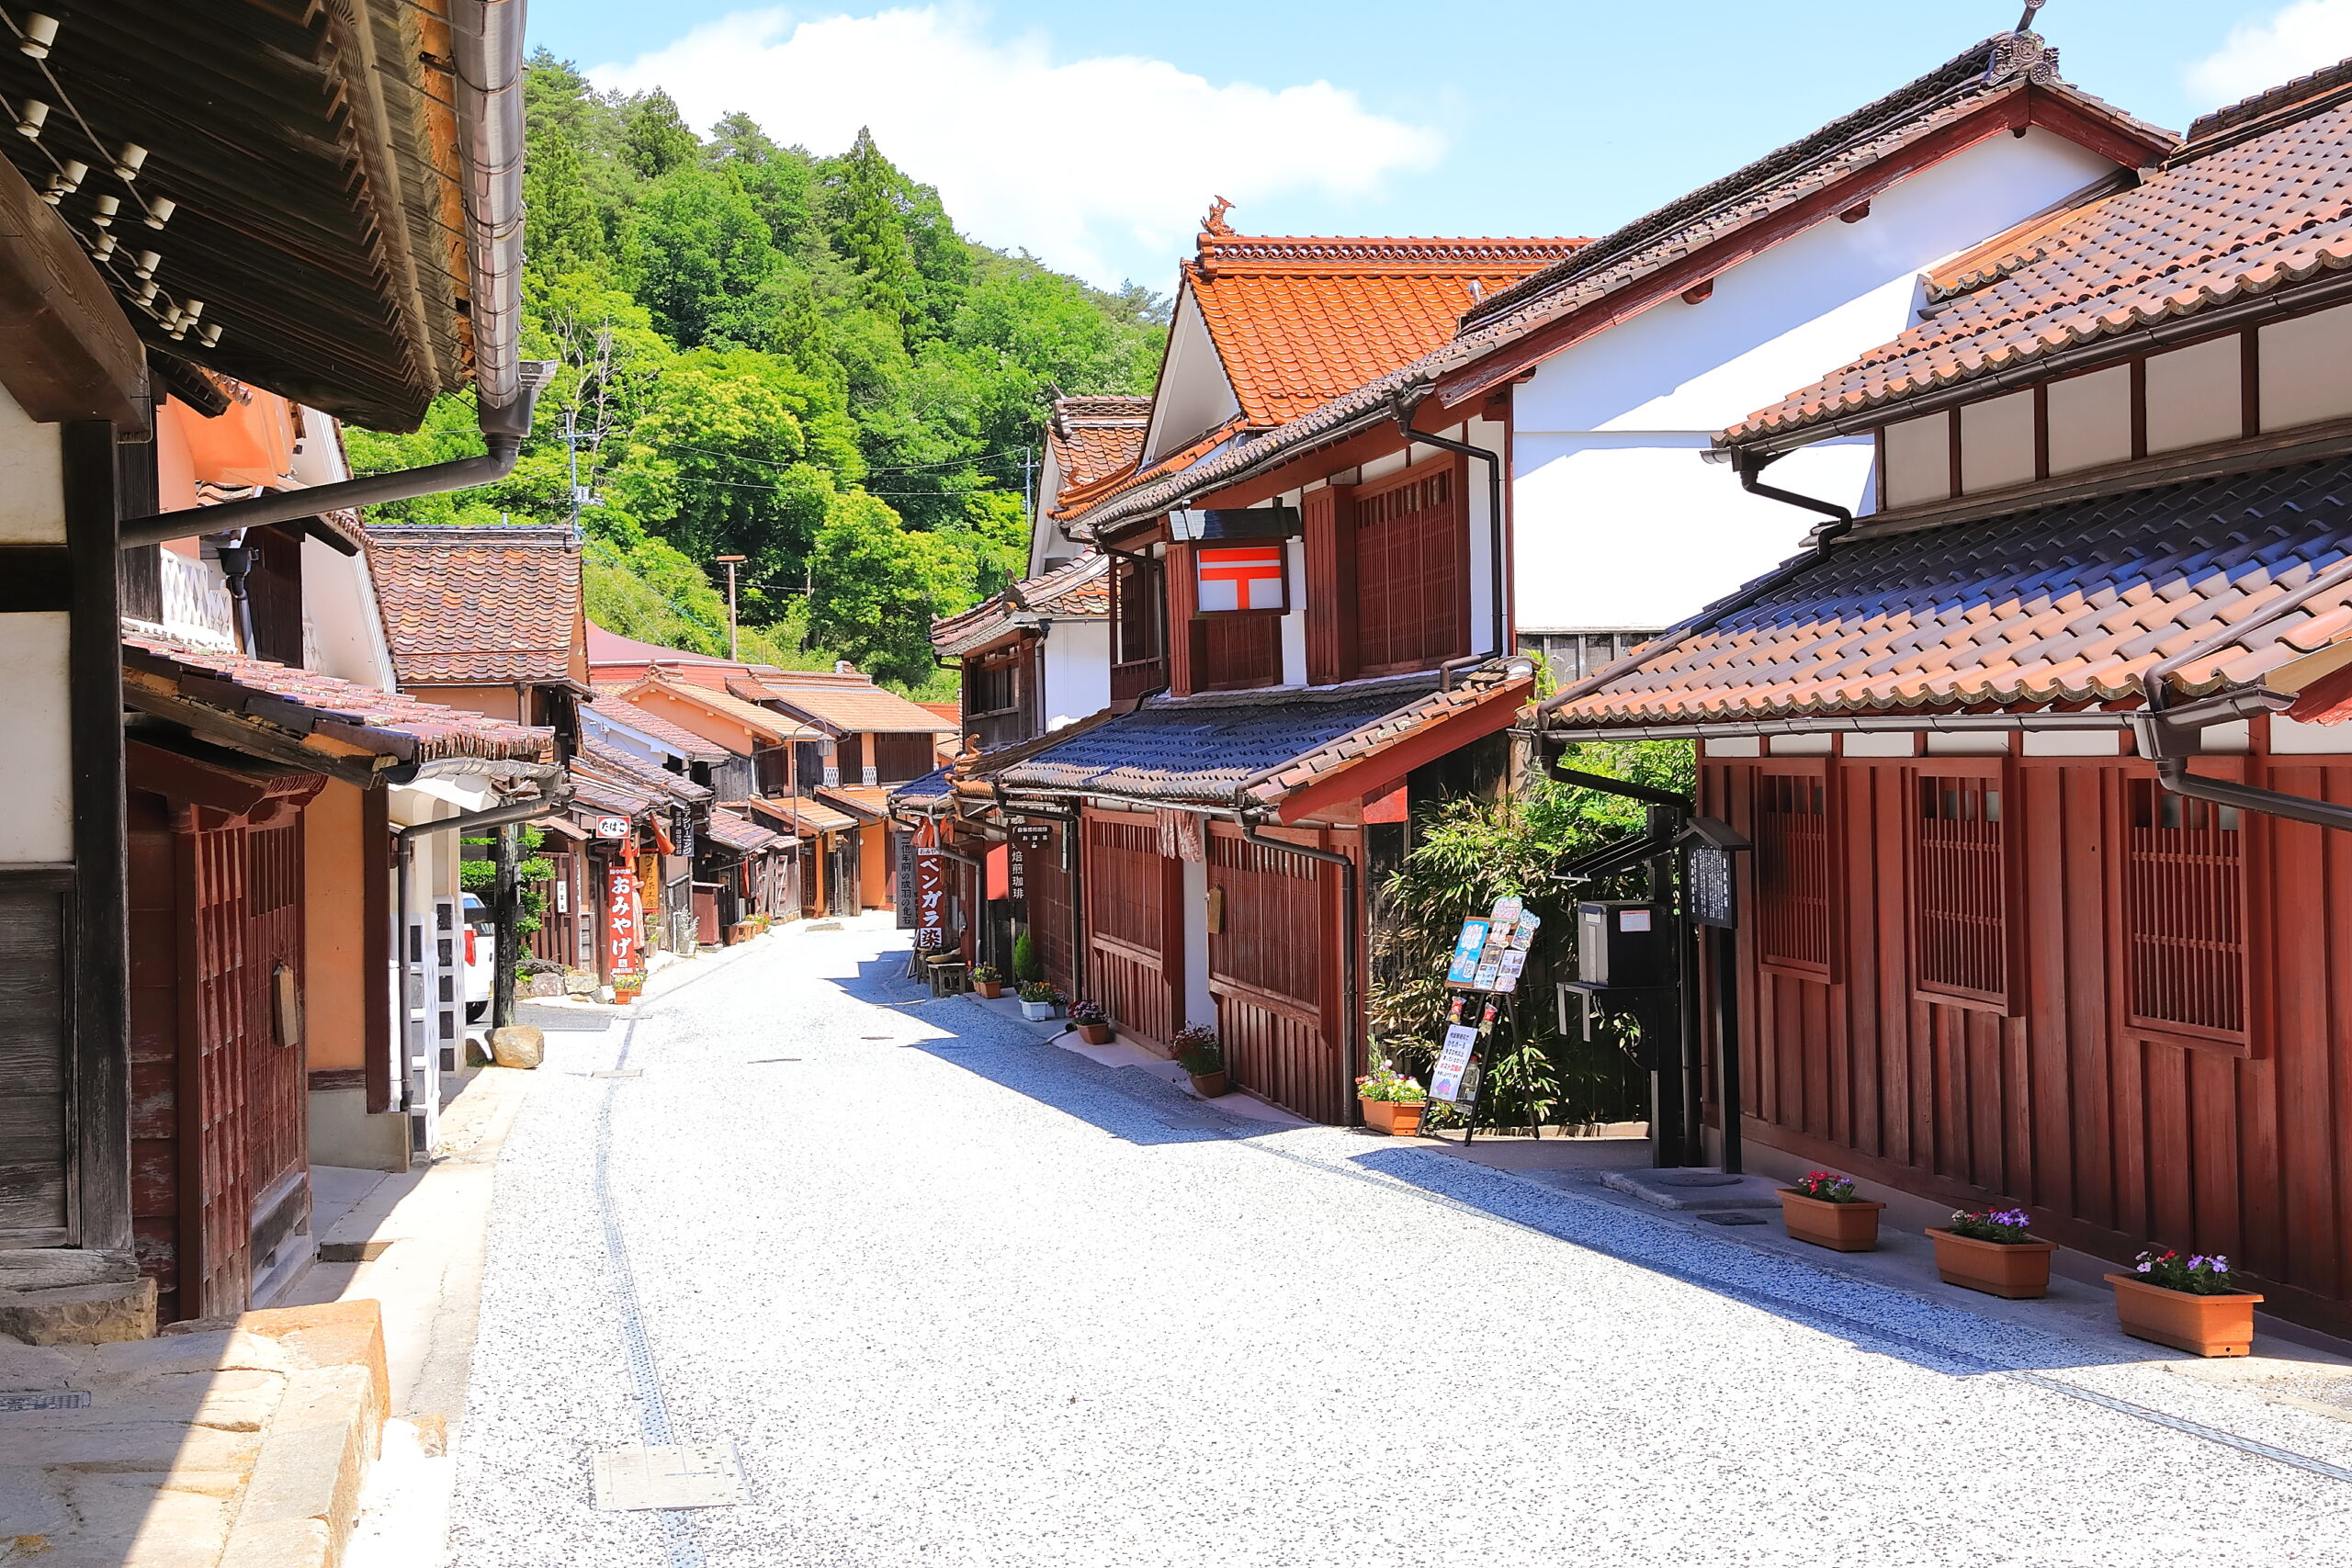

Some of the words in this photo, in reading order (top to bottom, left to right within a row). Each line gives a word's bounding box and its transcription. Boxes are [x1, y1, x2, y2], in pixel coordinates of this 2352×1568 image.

[920, 858, 943, 946] ベンガラ染
